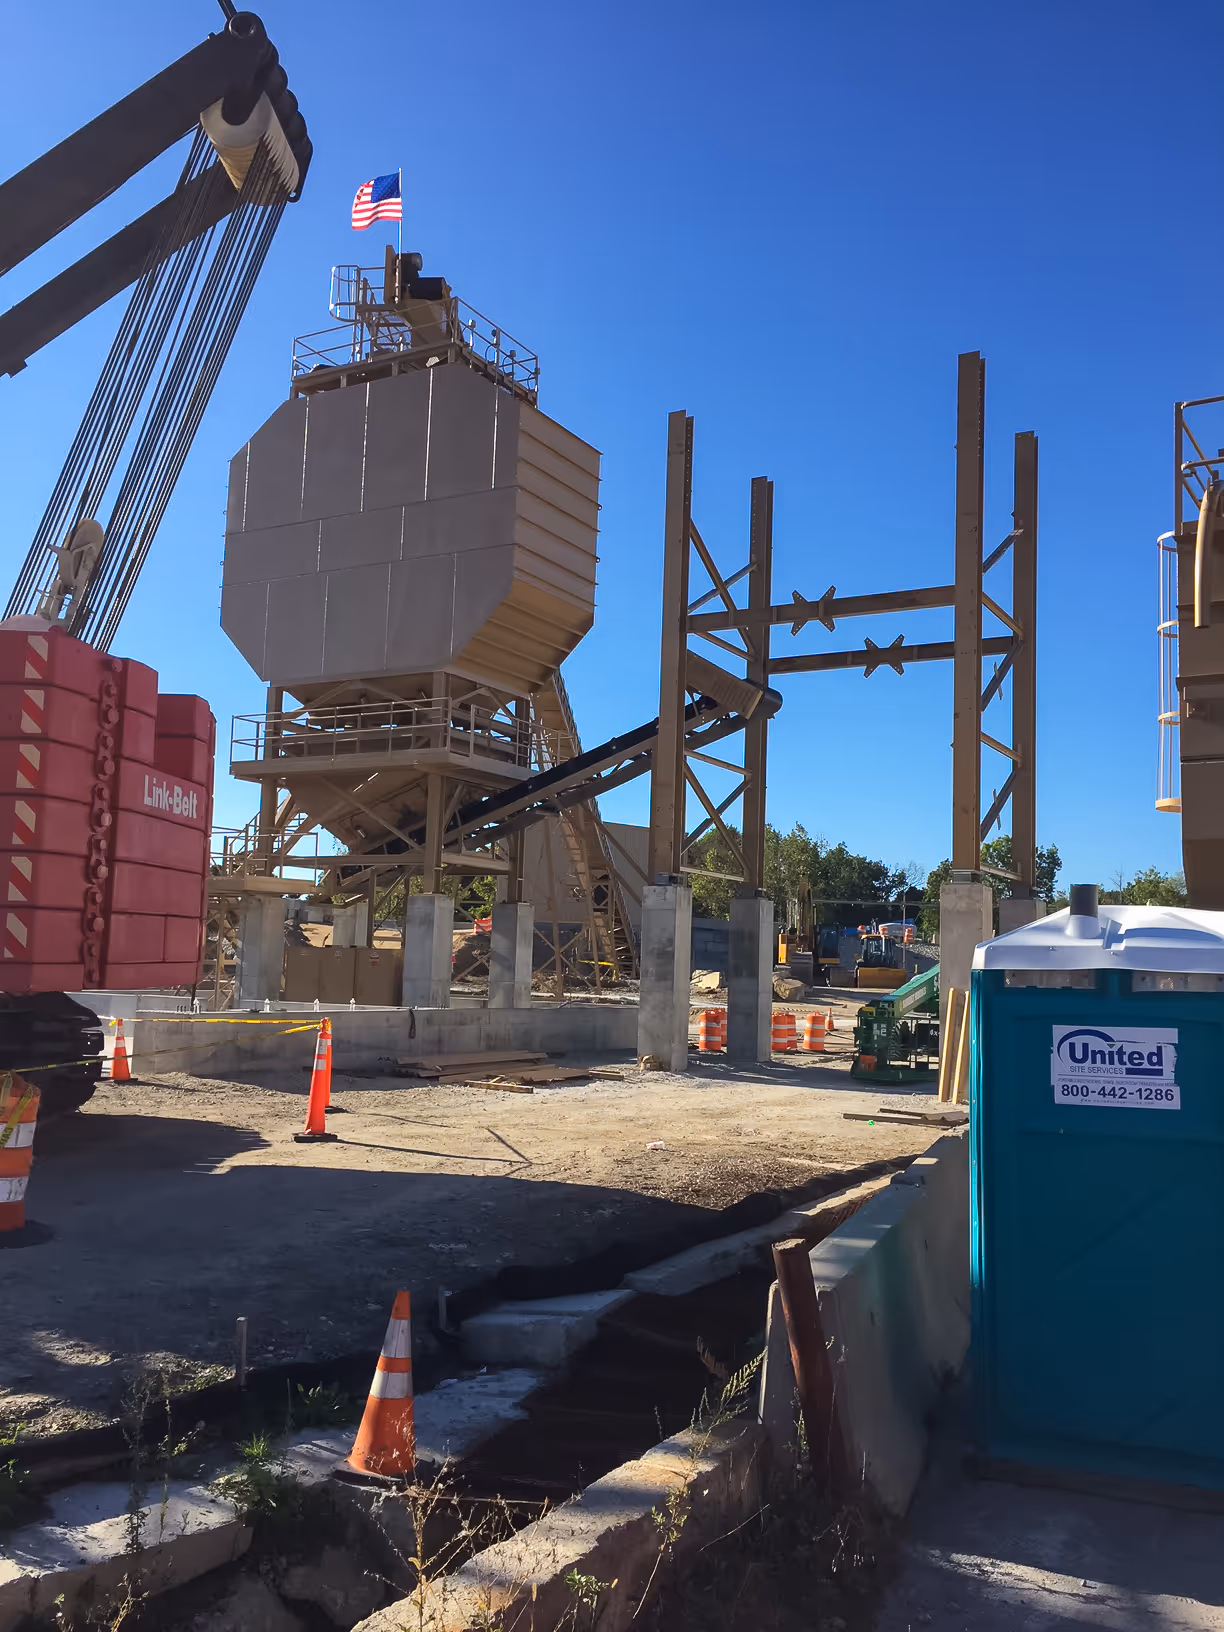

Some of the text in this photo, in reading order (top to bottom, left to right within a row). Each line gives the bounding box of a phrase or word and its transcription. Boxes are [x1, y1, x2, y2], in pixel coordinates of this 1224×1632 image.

[144, 775, 198, 818] Link-Belt
[1068, 1042, 1164, 1067] United
[1069, 1065, 1124, 1075] SITE SERVICES
[1061, 1084, 1175, 1102] 800-442-1286
